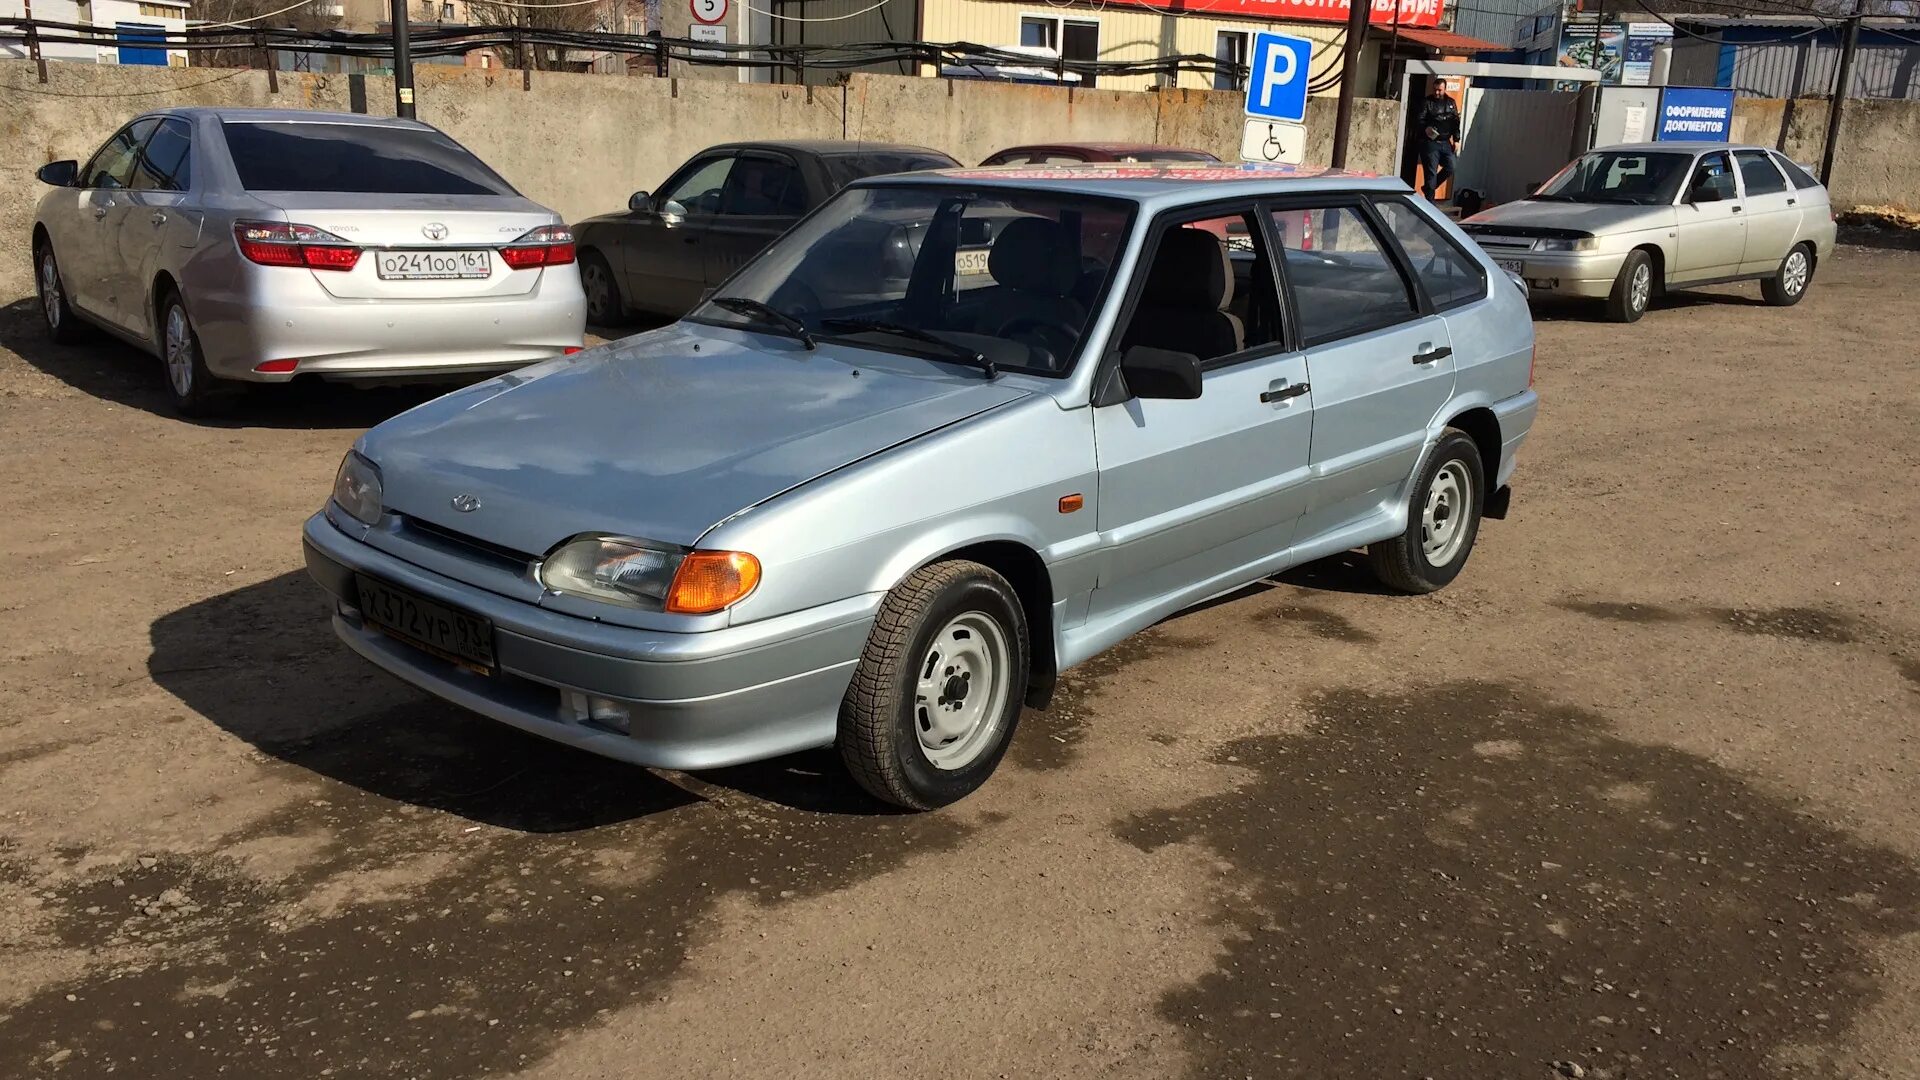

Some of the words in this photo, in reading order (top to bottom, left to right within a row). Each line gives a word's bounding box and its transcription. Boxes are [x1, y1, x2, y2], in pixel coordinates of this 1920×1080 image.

[705, 0, 714, 11] 5
[1260, 42, 1298, 108] P
[1666, 105, 1727, 118] ОФОРМЛЕНИЕ
[1664, 120, 1723, 132] ДОКУМЕНТОВ
[459, 252, 485, 266] 161
